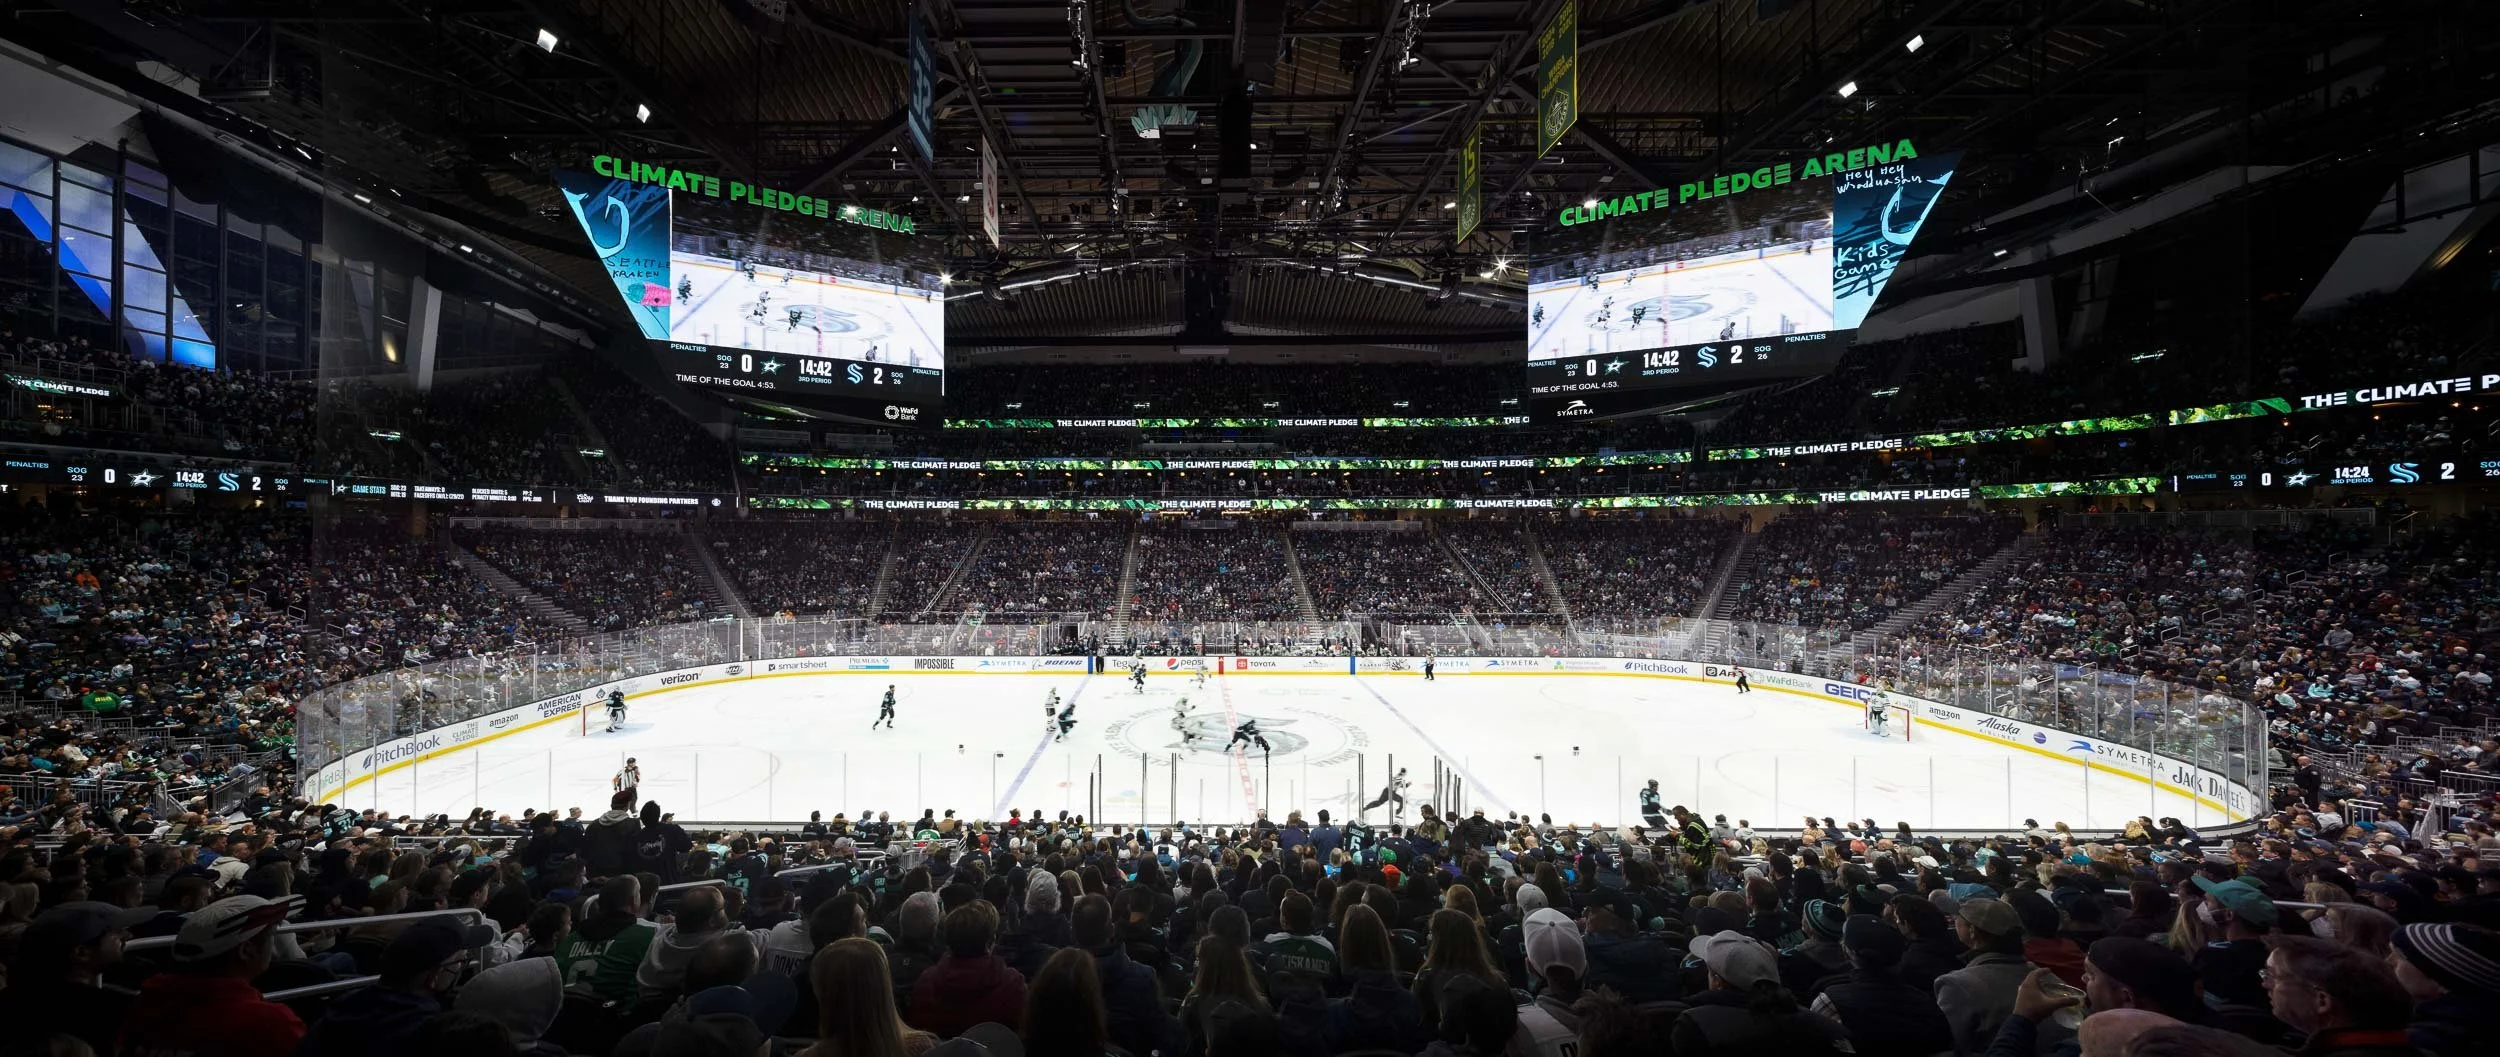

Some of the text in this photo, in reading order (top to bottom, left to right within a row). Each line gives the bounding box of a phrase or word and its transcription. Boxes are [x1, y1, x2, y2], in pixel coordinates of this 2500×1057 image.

[1463, 136, 1475, 181] 15
[1559, 139, 1918, 226] CLIMATE PLEDGE ARENA
[593, 155, 916, 234] CLIMATE PLEDGE ARENA
[1837, 241, 1888, 267] Kids
[613, 270, 659, 278] KRAKEN
[1835, 259, 1890, 279] Game
[1785, 333, 1827, 343] PENALTIES
[671, 343, 706, 352] PENALTIES
[1754, 345, 1771, 353] SOG
[717, 354, 732, 362] SOG
[1643, 350, 1680, 368] 14:42
[1730, 345, 1742, 364] 2
[741, 354, 753, 373] 0
[799, 358, 832, 377] 14:42
[1528, 360, 1557, 368] PENALTIES
[1586, 359, 1597, 376] 0
[873, 368, 882, 384] 2
[891, 371, 904, 379] SOG
[912, 368, 940, 376] PENALTIES
[1656, 367, 1680, 375] PERIOD
[676, 373, 697, 382] TIME
[713, 377, 731, 385] THE
[733, 379, 755, 387] GOAL
[34, 381, 73, 392] CLIMATE
[76, 387, 110, 396] PLEDGE
[1531, 385, 1549, 394] TIME
[1561, 384, 1577, 392] THE
[1579, 383, 1600, 391] GOAL
[2301, 391, 2347, 409] THE
[2355, 377, 2471, 403] CLIMATE
[900, 407, 918, 415] WaFd
[1556, 408, 1594, 417] SYMETRA
[1057, 419, 1137, 427] THE CLIMATE PLEDGE
[1766, 439, 1902, 456] THE CLIMATE PLEDGE
[6, 461, 49, 469] PENALTIES
[912, 461, 947, 469] CLIMATE
[950, 461, 981, 469] PLEDGE
[1443, 460, 1459, 468] THE
[1499, 459, 1534, 467] PLEDGE
[104, 469, 116, 484] 0
[176, 471, 205, 484] 14:42
[2334, 466, 2370, 479] 14:24
[2440, 462, 2455, 480] 2
[252, 476, 261, 490] 2
[2261, 472, 2271, 486] 0
[352, 485, 386, 494] GAME STATS
[1820, 488, 1970, 502] THE CLIMATE PLEDGE
[865, 500, 959, 509] THE CLIMATE PLEDGE
[1160, 500, 1251, 508] THE CLIMATE PLEDGE
[1456, 499, 1552, 508] THE CLIMATE PLEDGE
[778, 660, 827, 670] smartsheet
[914, 658, 955, 669] IMPOSSIBLE
[1112, 659, 1128, 669] Teg
[1181, 659, 1204, 667] pepsi
[1500, 659, 1539, 667] SYMETRA
[1634, 662, 1688, 674] PitchBook
[661, 673, 699, 685] verizon
[1766, 675, 1813, 688] WaFd Bank
[1825, 683, 1872, 701] GEIC
[537, 693, 582, 712] AMERICAN
[543, 701, 582, 718] EXPRESS
[1929, 706, 1960, 720] amazon
[489, 713, 519, 728] amazon
[1977, 717, 2021, 735] Alaska
[374, 735, 440, 764] PitchBook
[2097, 745, 2165, 772] SYMETRA
